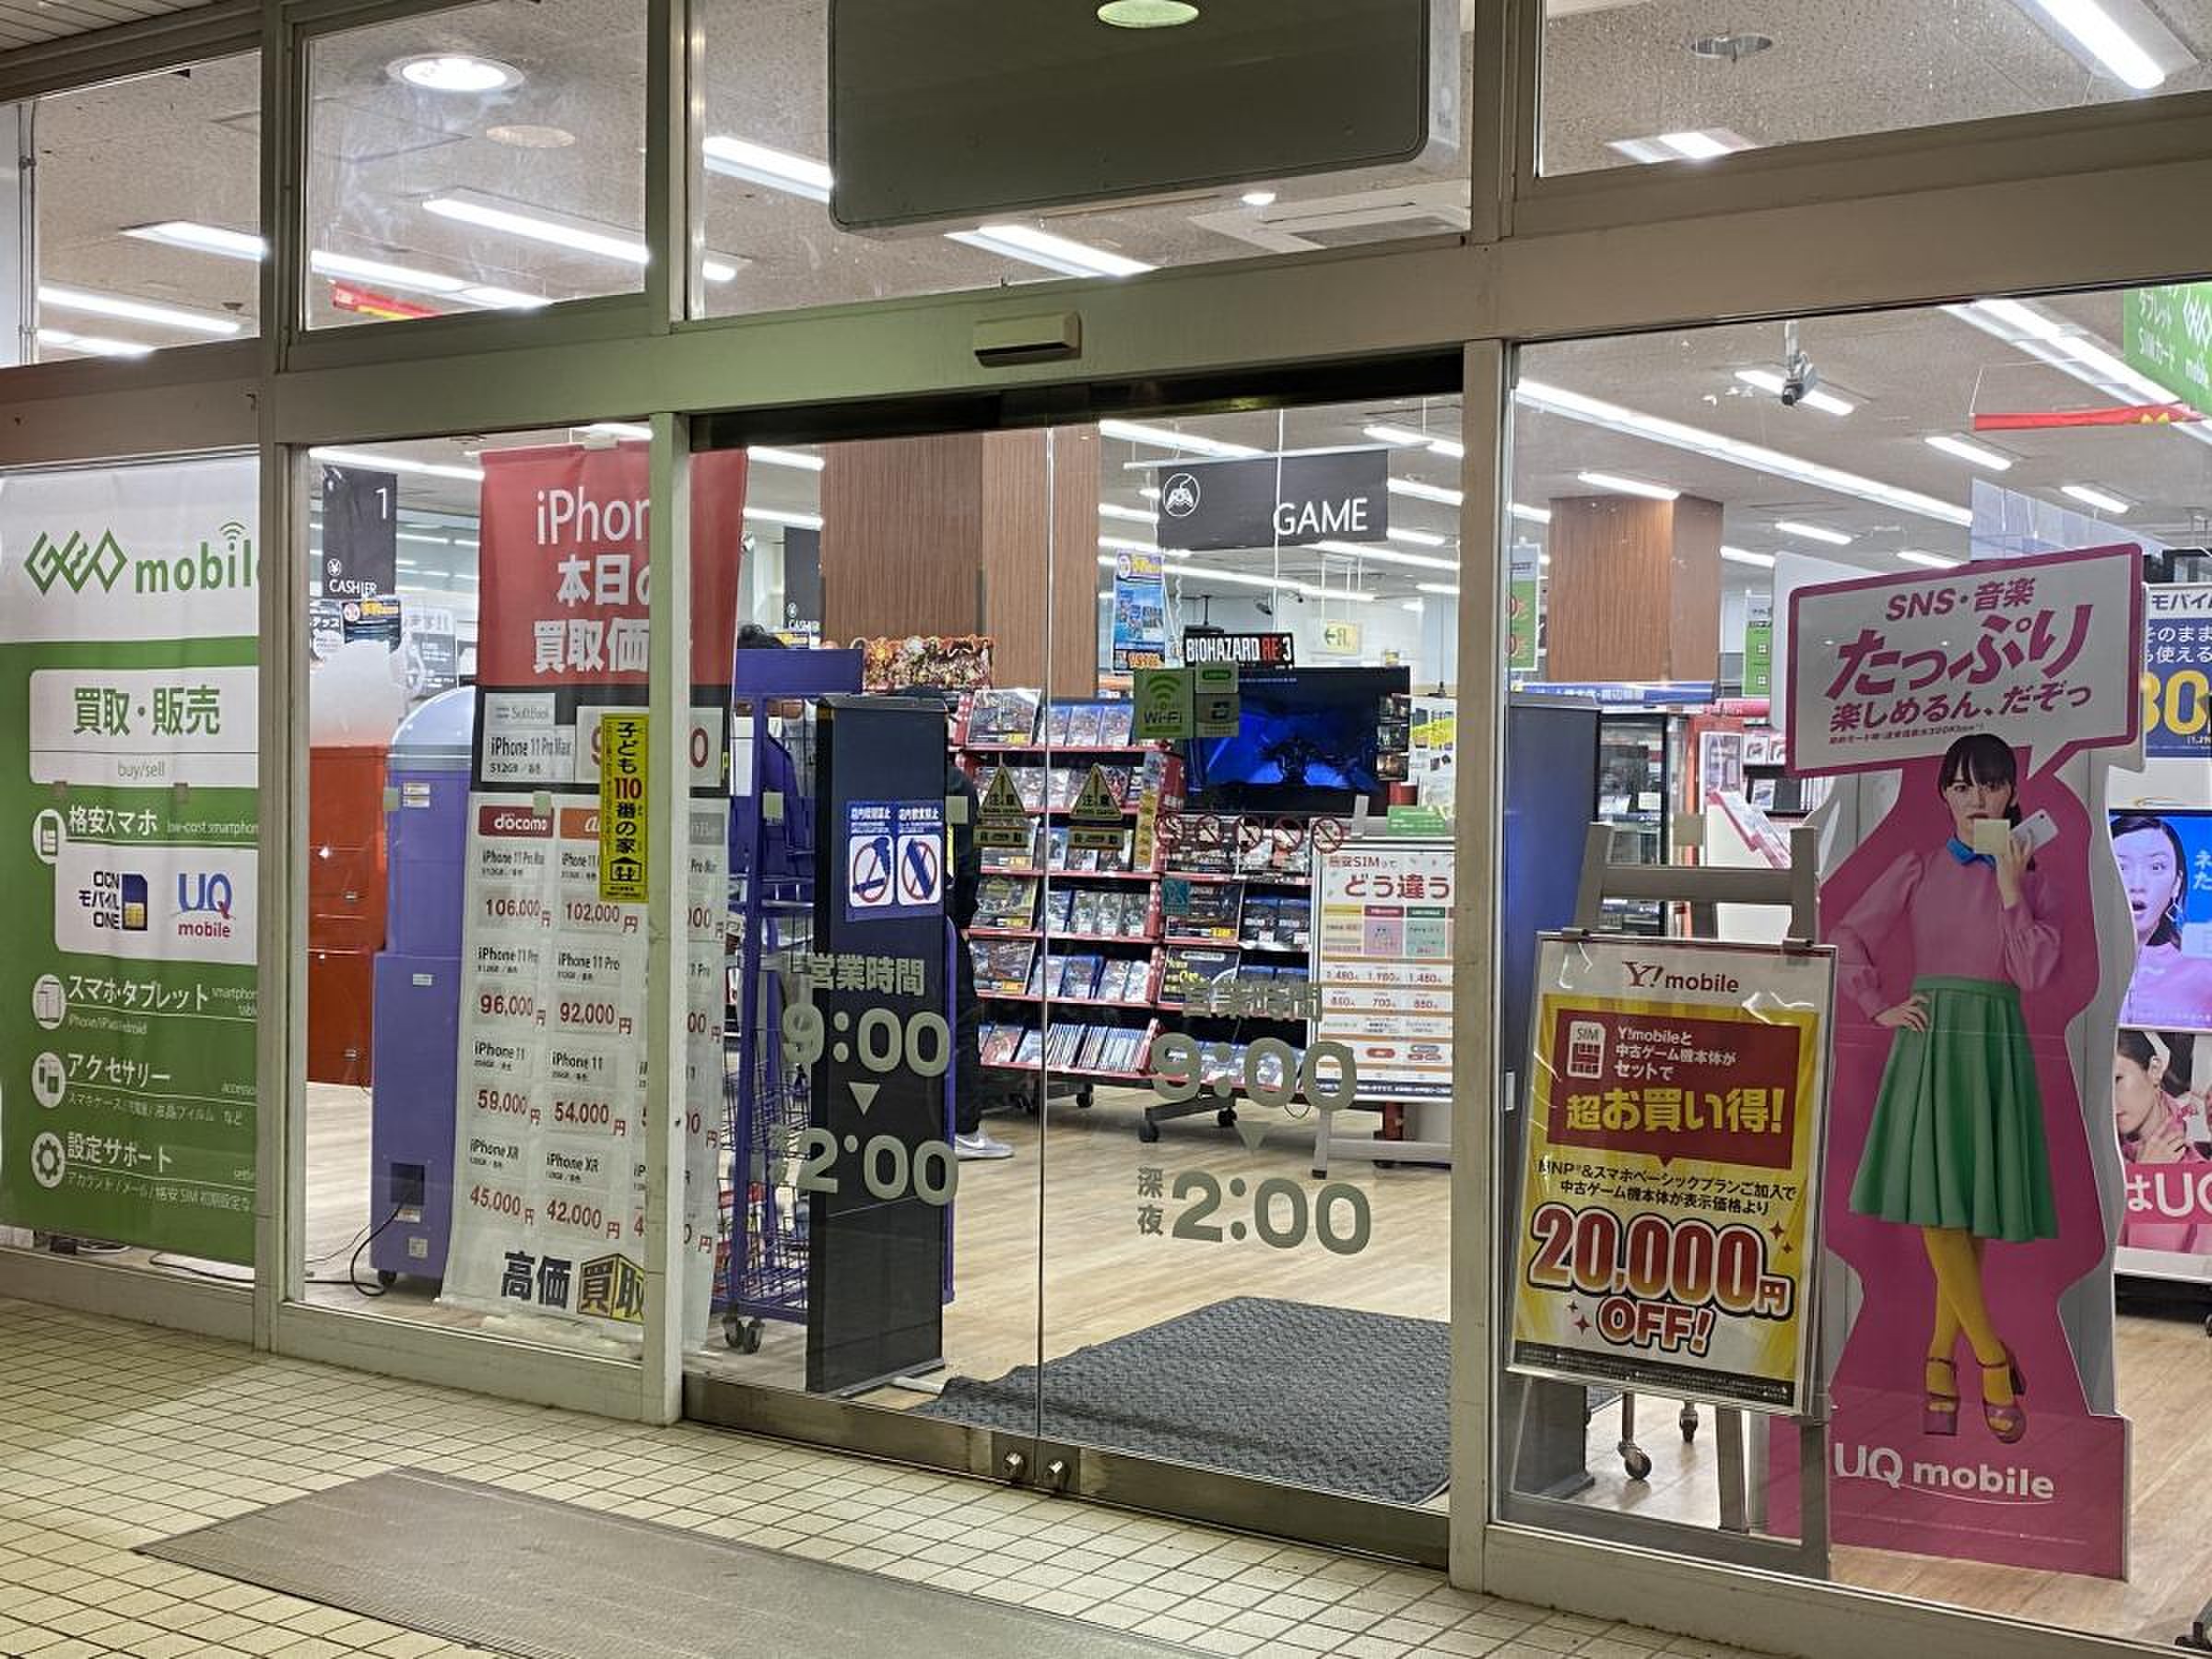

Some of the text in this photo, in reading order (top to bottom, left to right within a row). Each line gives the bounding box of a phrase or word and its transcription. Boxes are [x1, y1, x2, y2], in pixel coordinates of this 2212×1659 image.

[375, 487, 388, 520] 1
[1273, 498, 1369, 535] GAME
[135, 539, 257, 594] mobil
[328, 578, 378, 597] CASHIER
[1885, 577, 2036, 622] SNS・音楽
[2152, 594, 2212, 611] モバイ
[1185, 636, 1260, 663] BIOHAZARD
[1261, 637, 1280, 661] RE
[1282, 634, 1292, 660] 3
[1824, 604, 2094, 700] たっぷり
[73, 684, 221, 736] 買取・販売
[1829, 680, 2092, 734] 楽しめるん、だぞっ
[490, 737, 528, 757] iPhone
[118, 760, 166, 780] buy/sell
[68, 805, 158, 836] 格安スマホ
[93, 871, 119, 889] OCN
[1344, 873, 1451, 901] どう違う
[78, 889, 119, 911] モバイル
[177, 872, 233, 920] UQ
[93, 912, 119, 930] ONE
[177, 920, 230, 938] mobile
[558, 951, 591, 969] iPhone
[807, 952, 925, 996] 営業時間
[782, 1002, 951, 1077] 9:00
[1577, 1027, 1600, 1041] SIM
[474, 1041, 514, 1060] iPhone
[552, 1051, 589, 1070] iPhone
[67, 1052, 172, 1088] アクセサリー
[1152, 1031, 1358, 1112] 9:00
[1614, 1060, 1675, 1082] セットで
[67, 1130, 173, 1173] 設定サポート
[470, 1137, 505, 1157] iPhone
[547, 1151, 599, 1173] iPhone XR
[1136, 1166, 1372, 1256] 深夜 2:00
[1527, 1201, 1795, 1322] 20,000円
[1596, 1293, 1716, 1358] OFF!
[1834, 1442, 2055, 1500] UQ mobile
